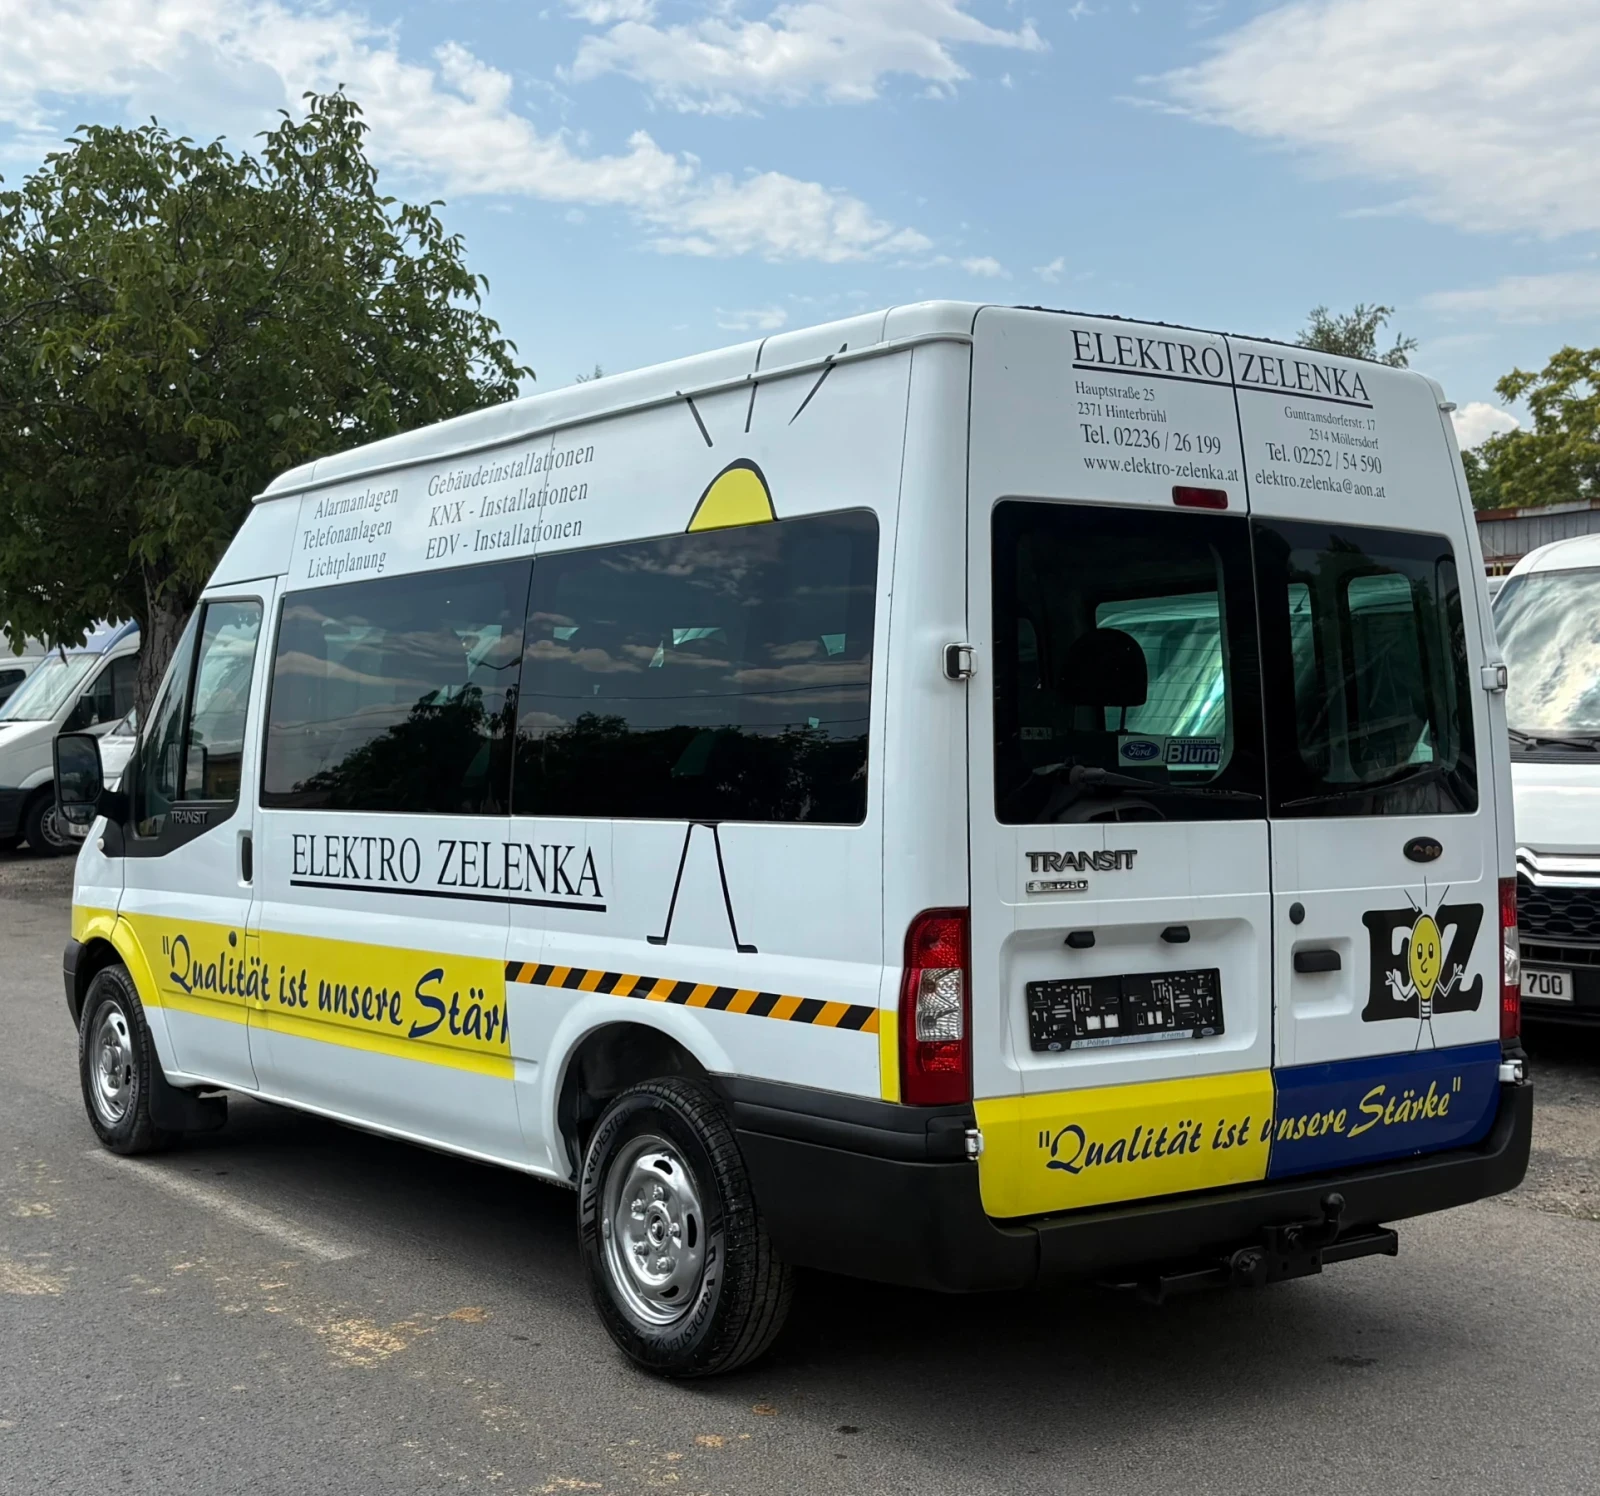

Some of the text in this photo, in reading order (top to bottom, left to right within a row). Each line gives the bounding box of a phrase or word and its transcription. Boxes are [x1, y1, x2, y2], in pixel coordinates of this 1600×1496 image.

[1070, 329, 1370, 401] ELEKTRO ZELENKA
[1075, 381, 1155, 401] Hauptstraße 25
[1077, 402, 1167, 423] 2371 Hinterbrühl
[1283, 406, 1376, 431] Guntramsdorferstr. 17
[1080, 423, 1109, 445] Tel.
[1113, 427, 1160, 450] 02236
[1174, 433, 1192, 453] 26
[1196, 434, 1221, 455] 199
[1308, 428, 1379, 450] 2514 Möllersdorf
[427, 445, 594, 497] Gebäudeinstallationen
[1083, 455, 1239, 482] www.elektro-zelenka.at
[1265, 442, 1291, 463] Tel.
[1293, 446, 1333, 468] 02252
[1342, 452, 1358, 471] 54
[1360, 454, 1382, 475] 590
[1255, 469, 1386, 499] elektro.zelenka@aon.at
[313, 487, 399, 520] Alarmanlagen
[428, 500, 466, 528] KNX
[479, 482, 589, 519] Installationen
[302, 520, 392, 550] Telefonanlagen
[425, 532, 460, 560] EDV
[473, 519, 583, 552] Installationen
[307, 551, 387, 580] Lichtplanung
[1128, 744, 1152, 757] Ford
[1167, 744, 1219, 763] Blum
[170, 811, 207, 824] TRANSIT
[292, 833, 604, 898] ELEKTRO ZELENKA
[1025, 849, 1137, 872] TRANSIT
[279, 963, 308, 1007] ist
[318, 978, 404, 1026] unsere
[1525, 973, 1564, 996] 700
[1211, 1115, 1250, 1151] ist
[1258, 1107, 1346, 1144] unsere
